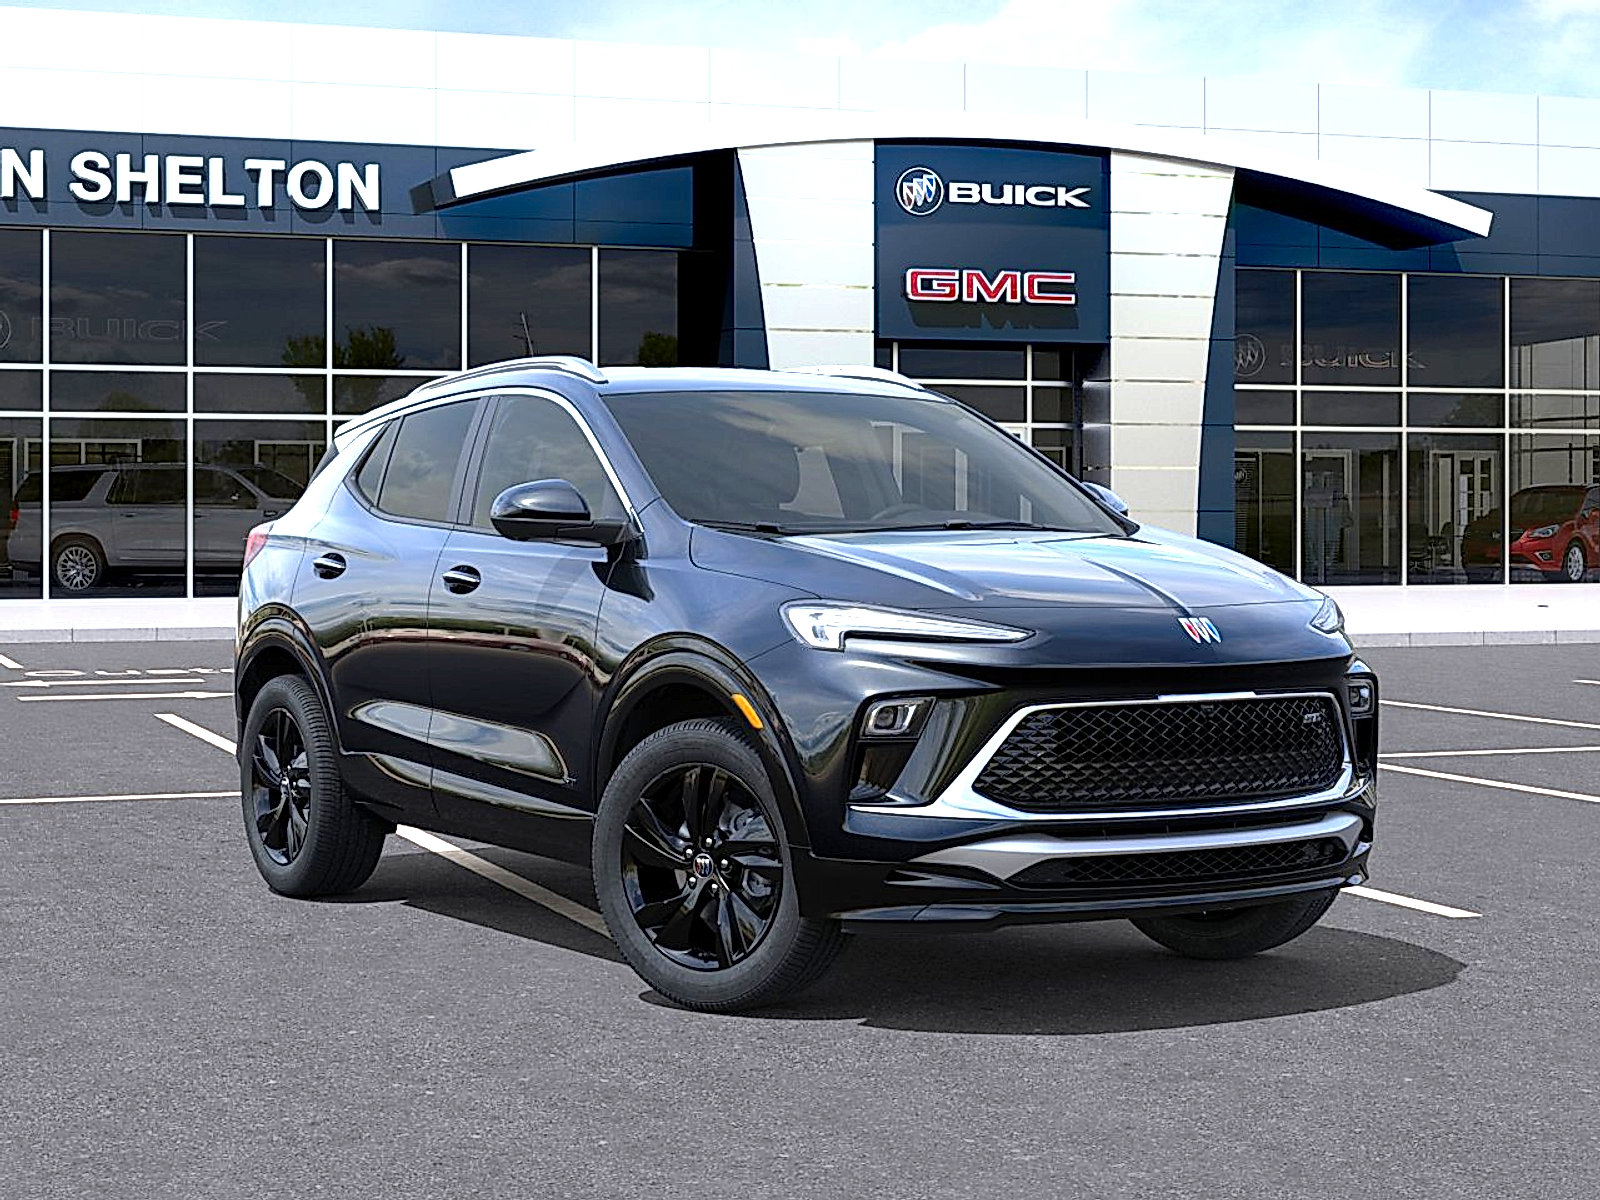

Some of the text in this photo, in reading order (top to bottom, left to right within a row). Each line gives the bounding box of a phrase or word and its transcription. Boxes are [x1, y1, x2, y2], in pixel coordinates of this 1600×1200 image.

[69, 150, 380, 211] SHELTON
[948, 182, 1092, 208] BUICK
[906, 268, 1076, 305] GMC
